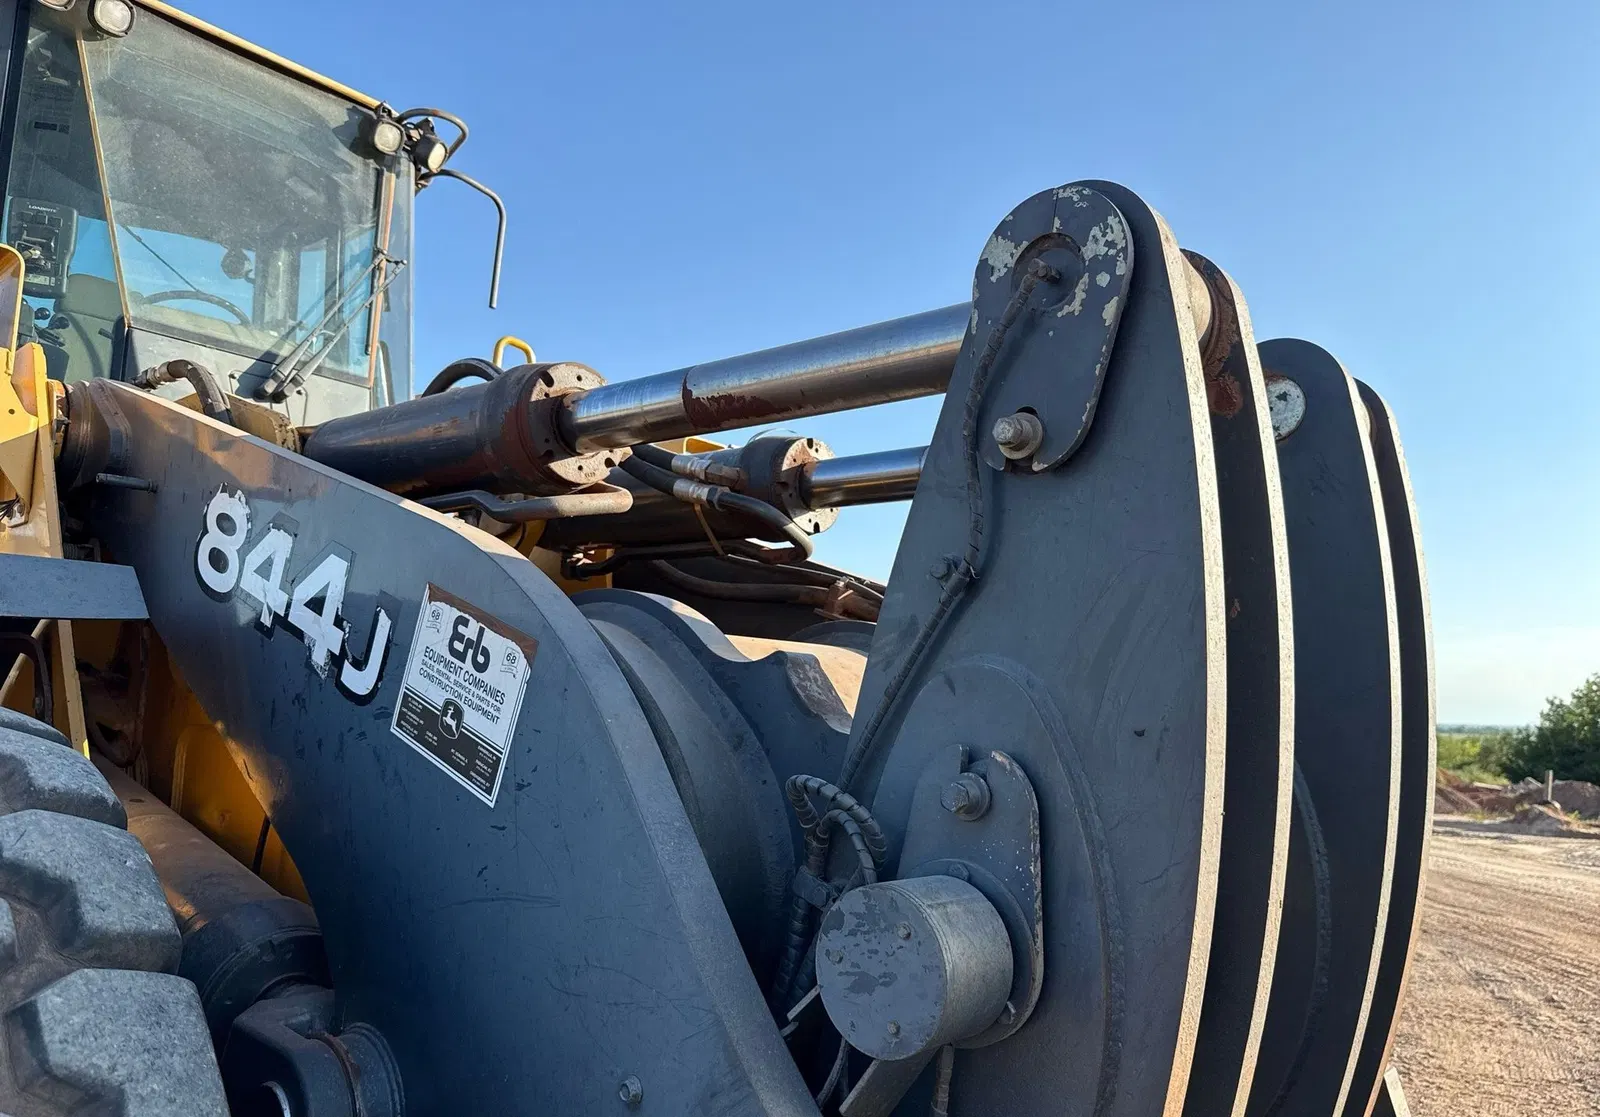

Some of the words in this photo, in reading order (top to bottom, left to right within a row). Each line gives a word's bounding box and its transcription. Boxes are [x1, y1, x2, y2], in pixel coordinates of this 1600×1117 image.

[431, 609, 441, 621] 68
[448, 614, 491, 673] Erb
[505, 652, 517, 665] 68
[418, 667, 464, 703] CONSTRUCTION
[463, 695, 500, 725] EQUIPMENT
[424, 646, 463, 677] EQUIPMENT
[463, 671, 505, 705] COMPANIES
[452, 677, 471, 695] SERVICE
[475, 692, 491, 708] PARTS
